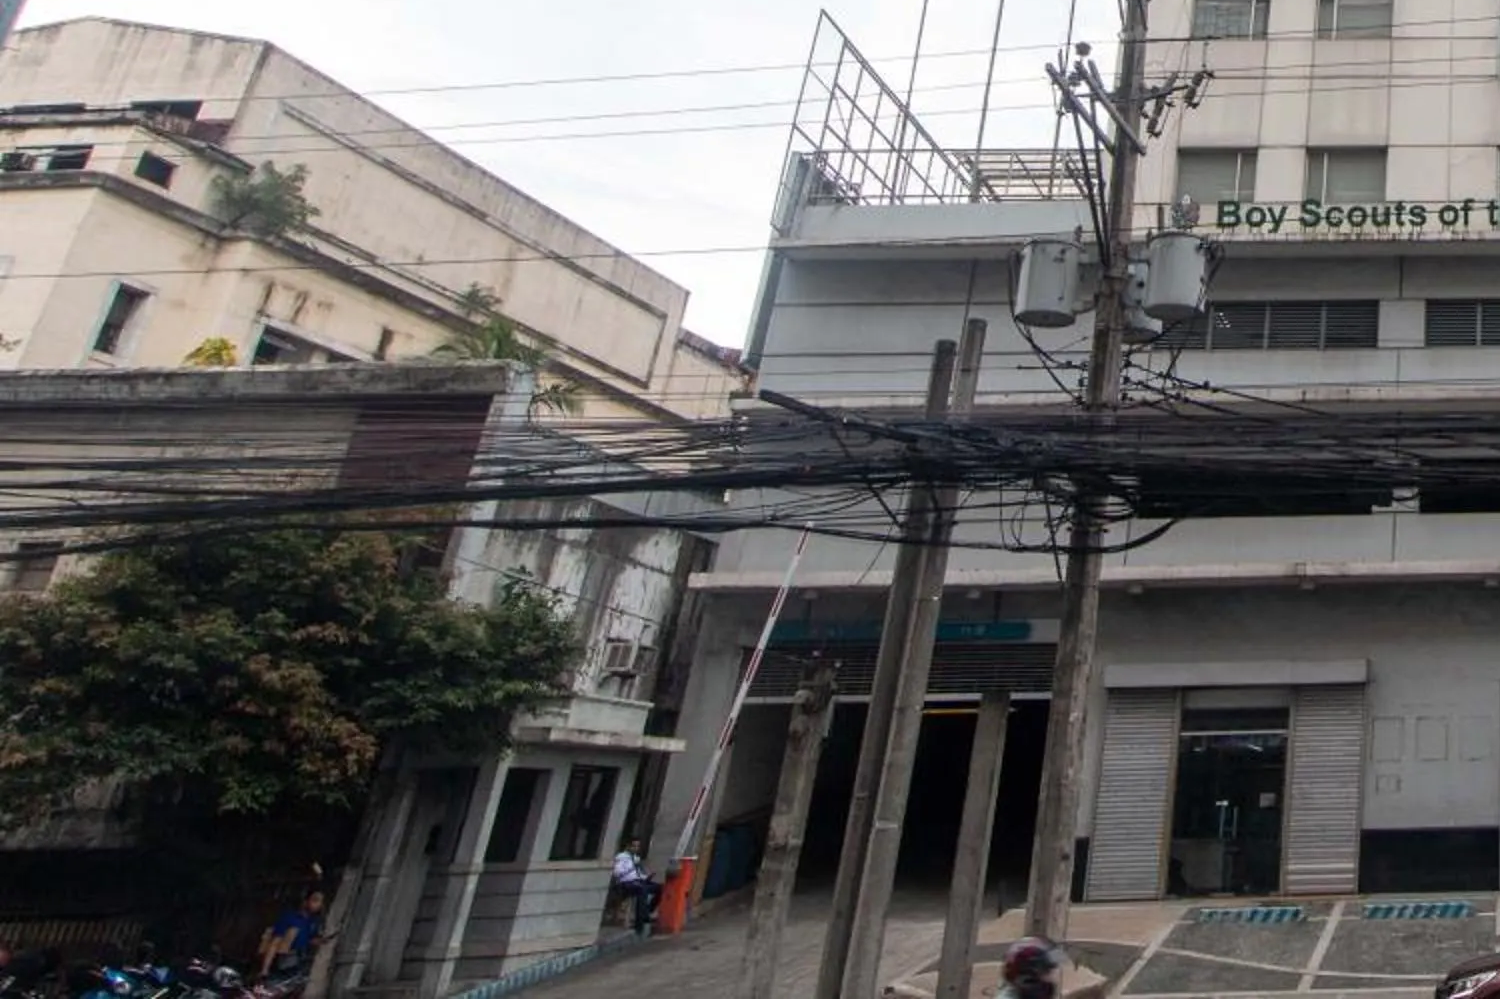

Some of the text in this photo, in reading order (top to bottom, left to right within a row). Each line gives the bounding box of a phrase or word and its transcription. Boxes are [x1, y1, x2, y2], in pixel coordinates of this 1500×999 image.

[1215, 199, 1288, 232] Boy
[1300, 198, 1428, 228] Scouts
[1438, 198, 1475, 227] of
